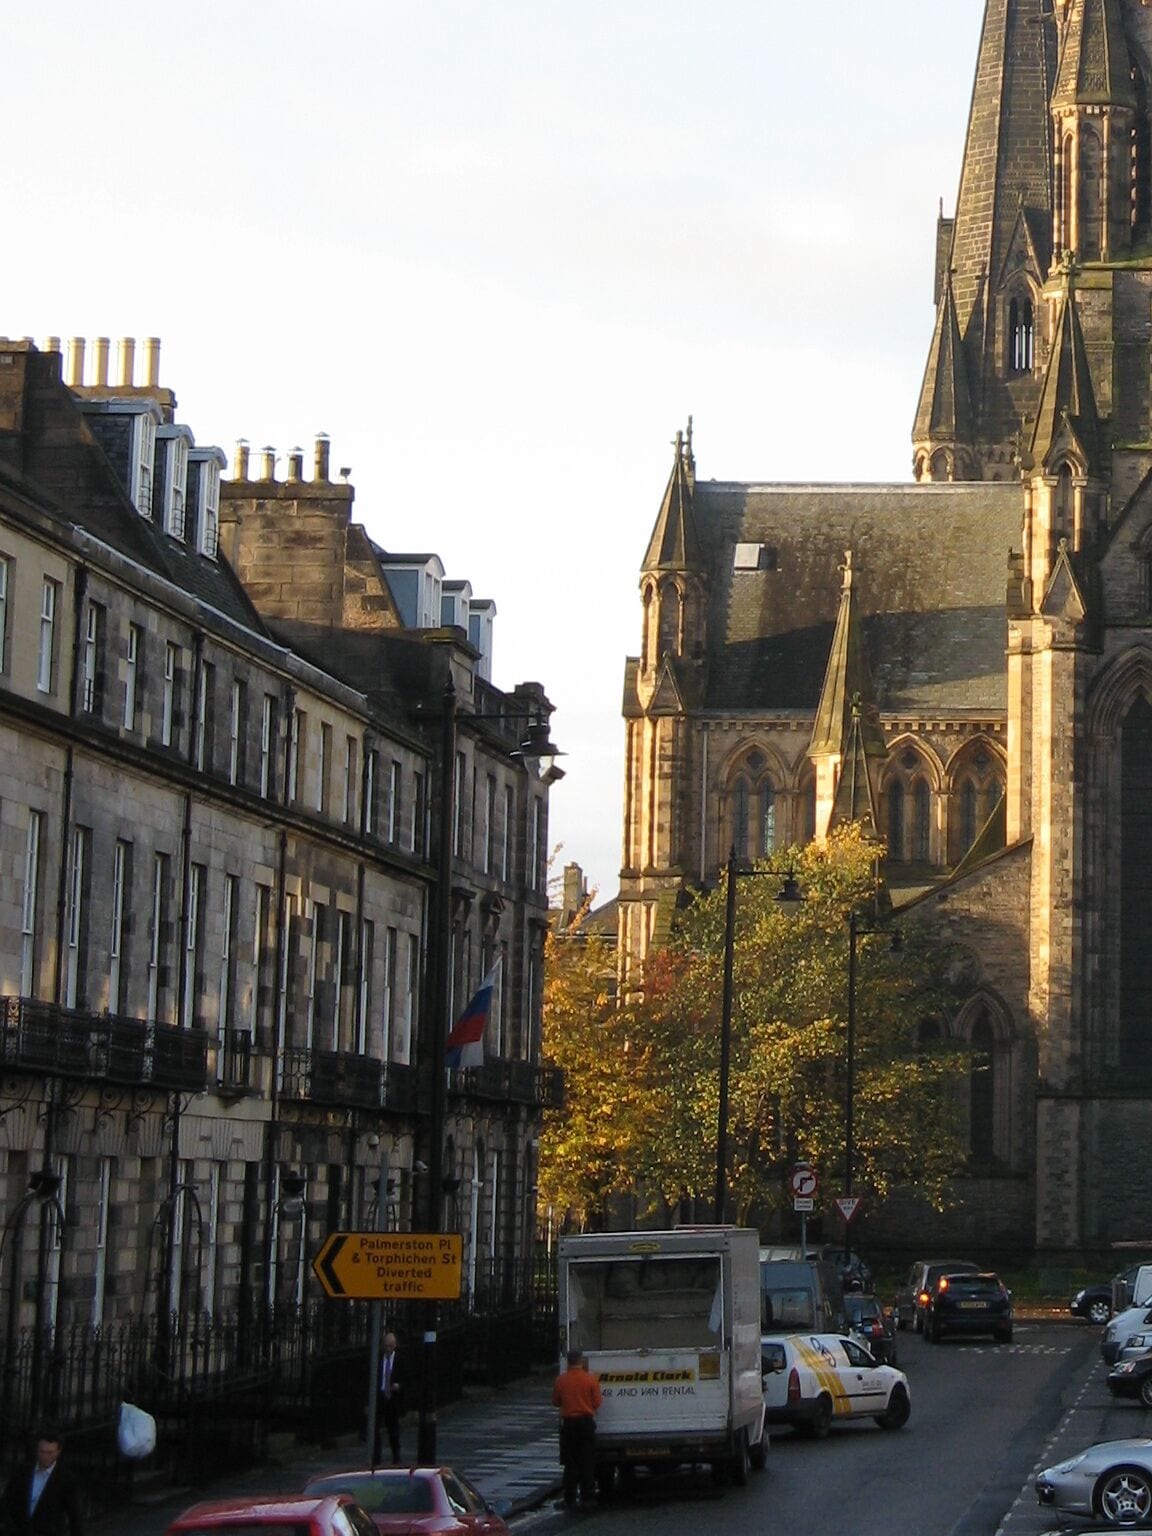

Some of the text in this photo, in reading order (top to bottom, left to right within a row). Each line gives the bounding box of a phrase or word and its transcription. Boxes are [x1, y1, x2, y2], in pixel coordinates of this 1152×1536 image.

[360, 1238, 451, 1251] Palmerston Pl
[352, 1252, 456, 1266] & Torphichen St
[377, 1267, 432, 1278] Diverted
[384, 1281, 424, 1293] traffic
[598, 1369, 691, 1382] Arnold Clark
[601, 1385, 695, 1398] AR AND VAN RENTAL
